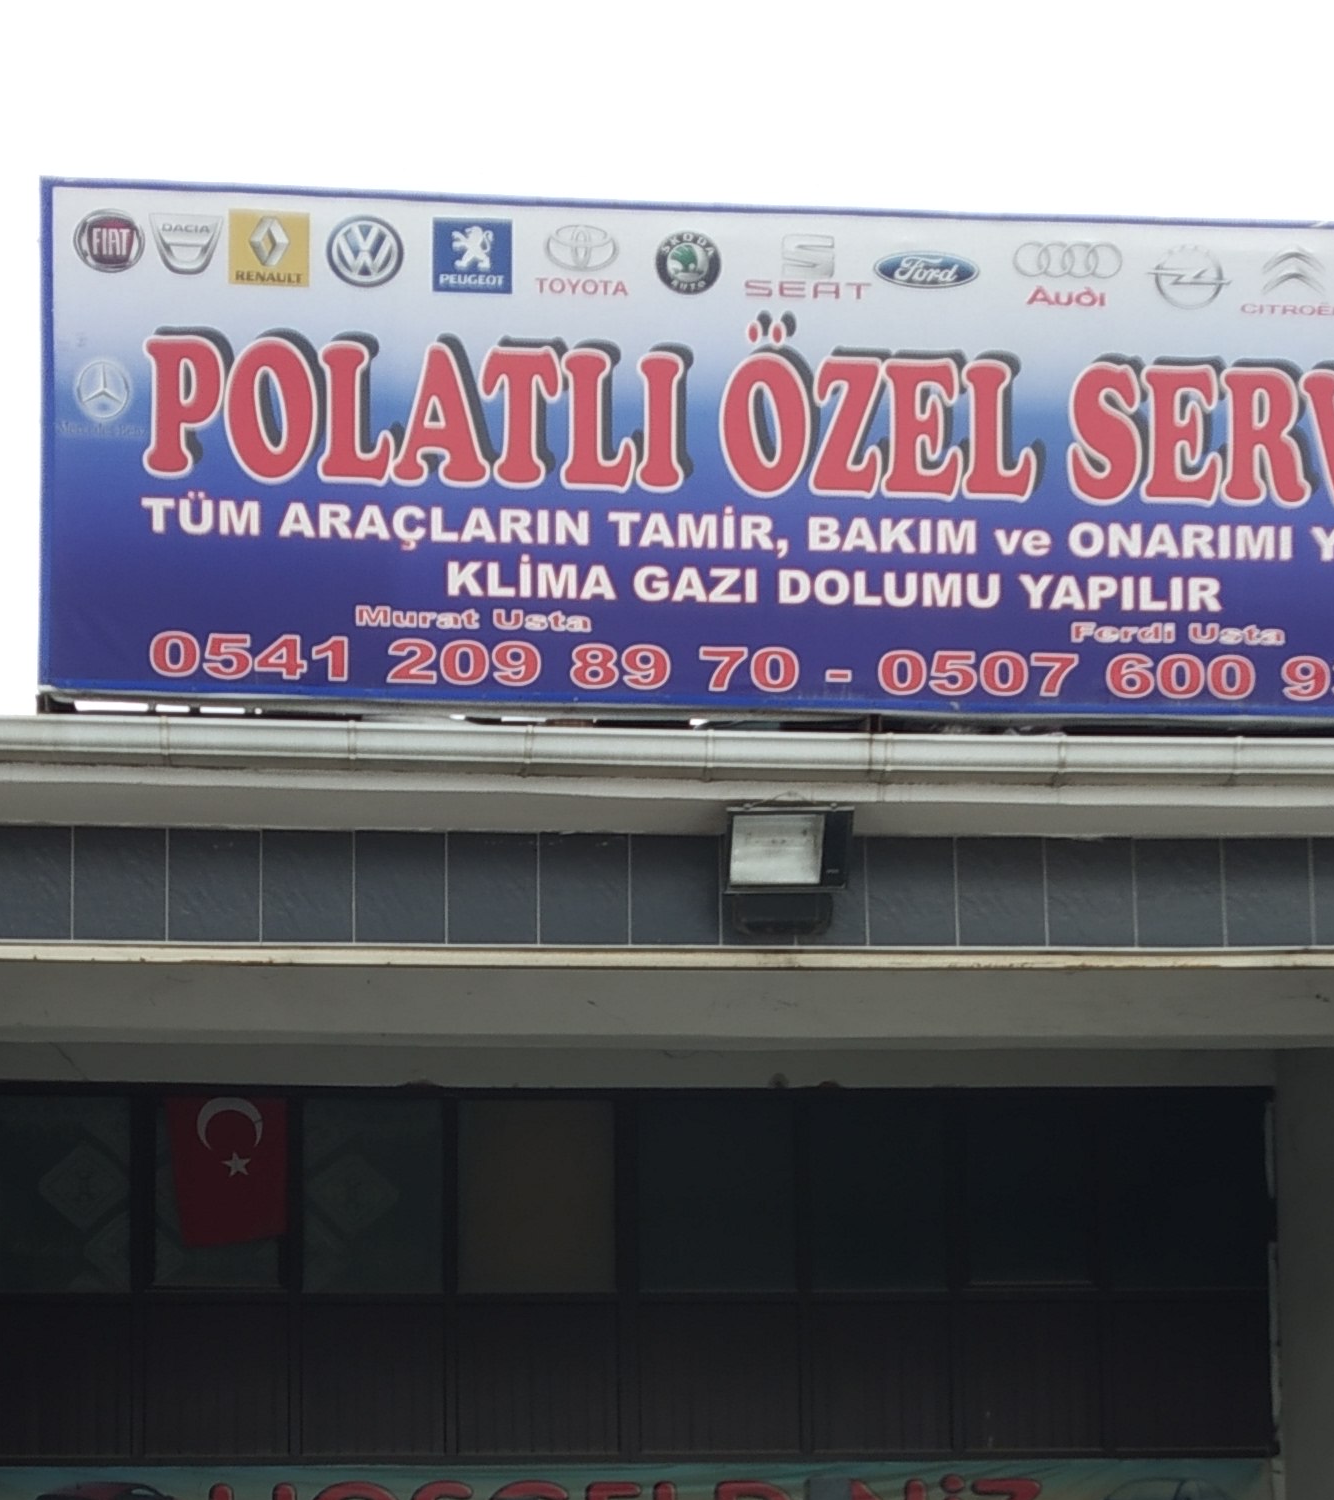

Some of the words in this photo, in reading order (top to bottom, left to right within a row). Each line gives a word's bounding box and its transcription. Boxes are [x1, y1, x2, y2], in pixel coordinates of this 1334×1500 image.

[92, 227, 131, 257] FIAT
[161, 222, 211, 235] DACIA
[235, 269, 304, 285] RENAULT
[438, 272, 505, 288] PEUGEOT
[897, 256, 959, 284] Ford
[536, 277, 628, 297] TOYOTA
[745, 279, 871, 300] SEAT
[143, 330, 691, 494] POLATLI
[719, 312, 1043, 503] ÖZEL
[142, 493, 260, 536] TÜM
[279, 502, 590, 550] ARAÇLARIN
[608, 505, 788, 558] TAMİR,
[810, 515, 978, 556] BAKIM
[994, 529, 1052, 557] ve
[1068, 521, 1292, 561] ONARIMI
[446, 553, 617, 600] KLİMA
[633, 565, 758, 604] GAZI
[778, 567, 1001, 610] DOLUMU
[1020, 574, 1223, 612] YAPILIR
[355, 604, 480, 630] Murat
[492, 608, 593, 633] Usta
[1071, 620, 1174, 644] Ferdi
[1188, 622, 1287, 645] Usta
[149, 630, 350, 682] 0541
[386, 637, 542, 686] 209
[569, 643, 671, 691] 89
[699, 645, 801, 694] 70
[876, 648, 1080, 698] 0507
[1105, 653, 1256, 702] 600
